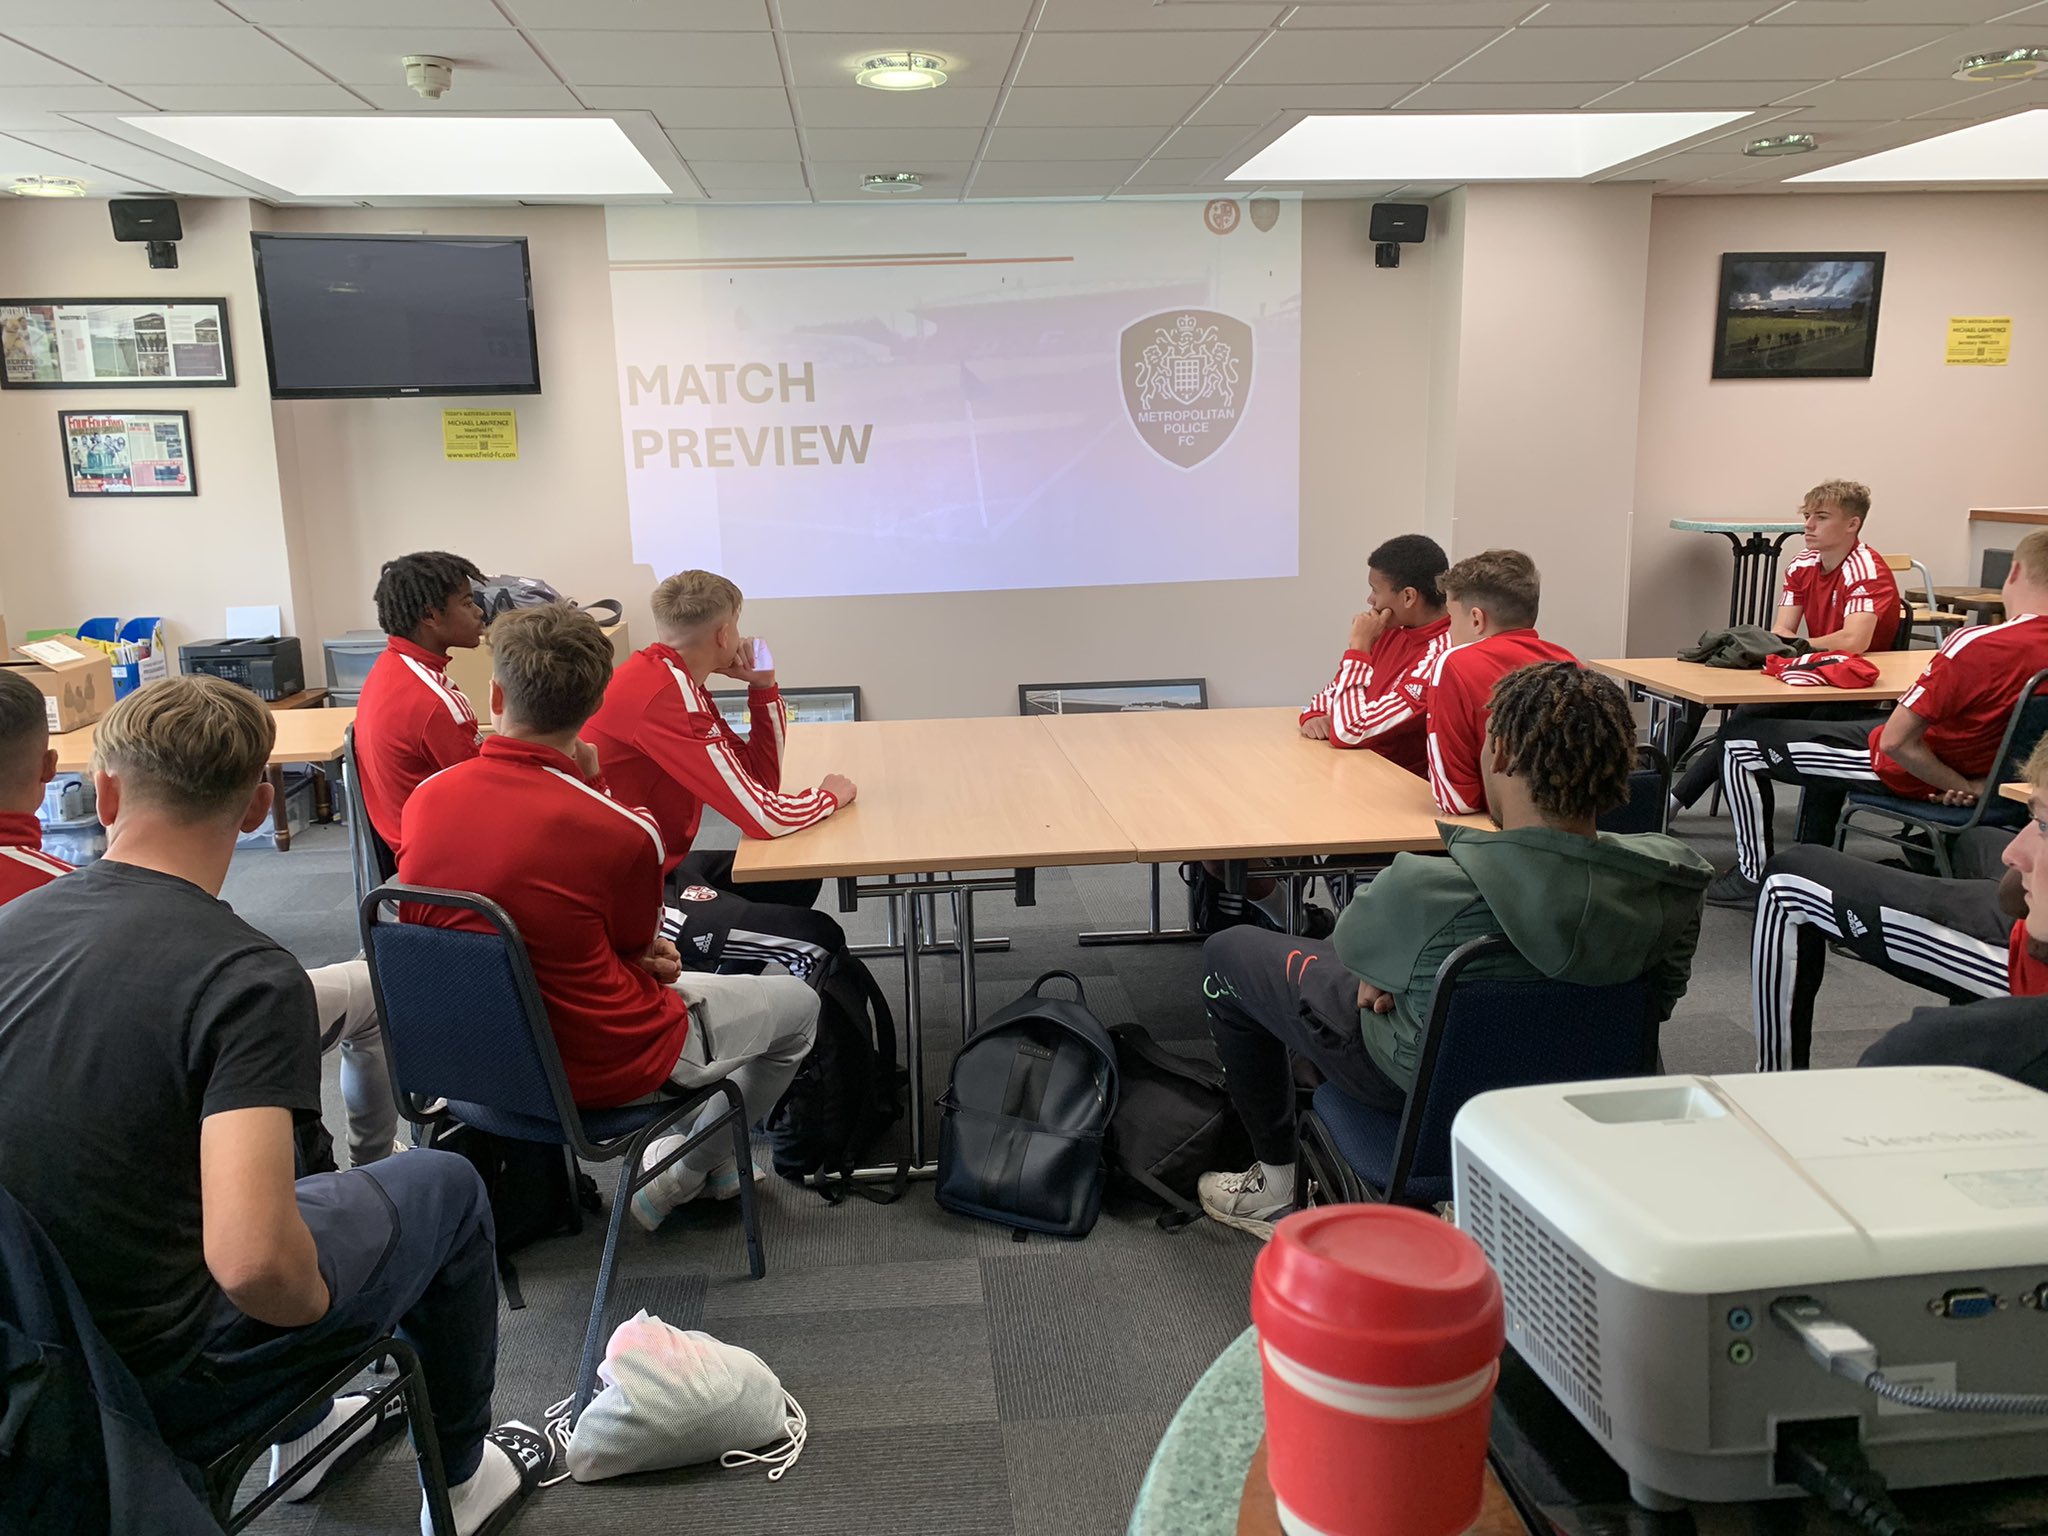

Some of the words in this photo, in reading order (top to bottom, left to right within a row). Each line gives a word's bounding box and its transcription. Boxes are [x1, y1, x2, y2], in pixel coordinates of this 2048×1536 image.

[626, 361, 816, 406] MATCH
[1137, 408, 1235, 423] METROPOLITAN
[1163, 423, 1209, 434] POLICE
[632, 423, 874, 470] PREVIEW
[1178, 435, 1195, 446] FC
